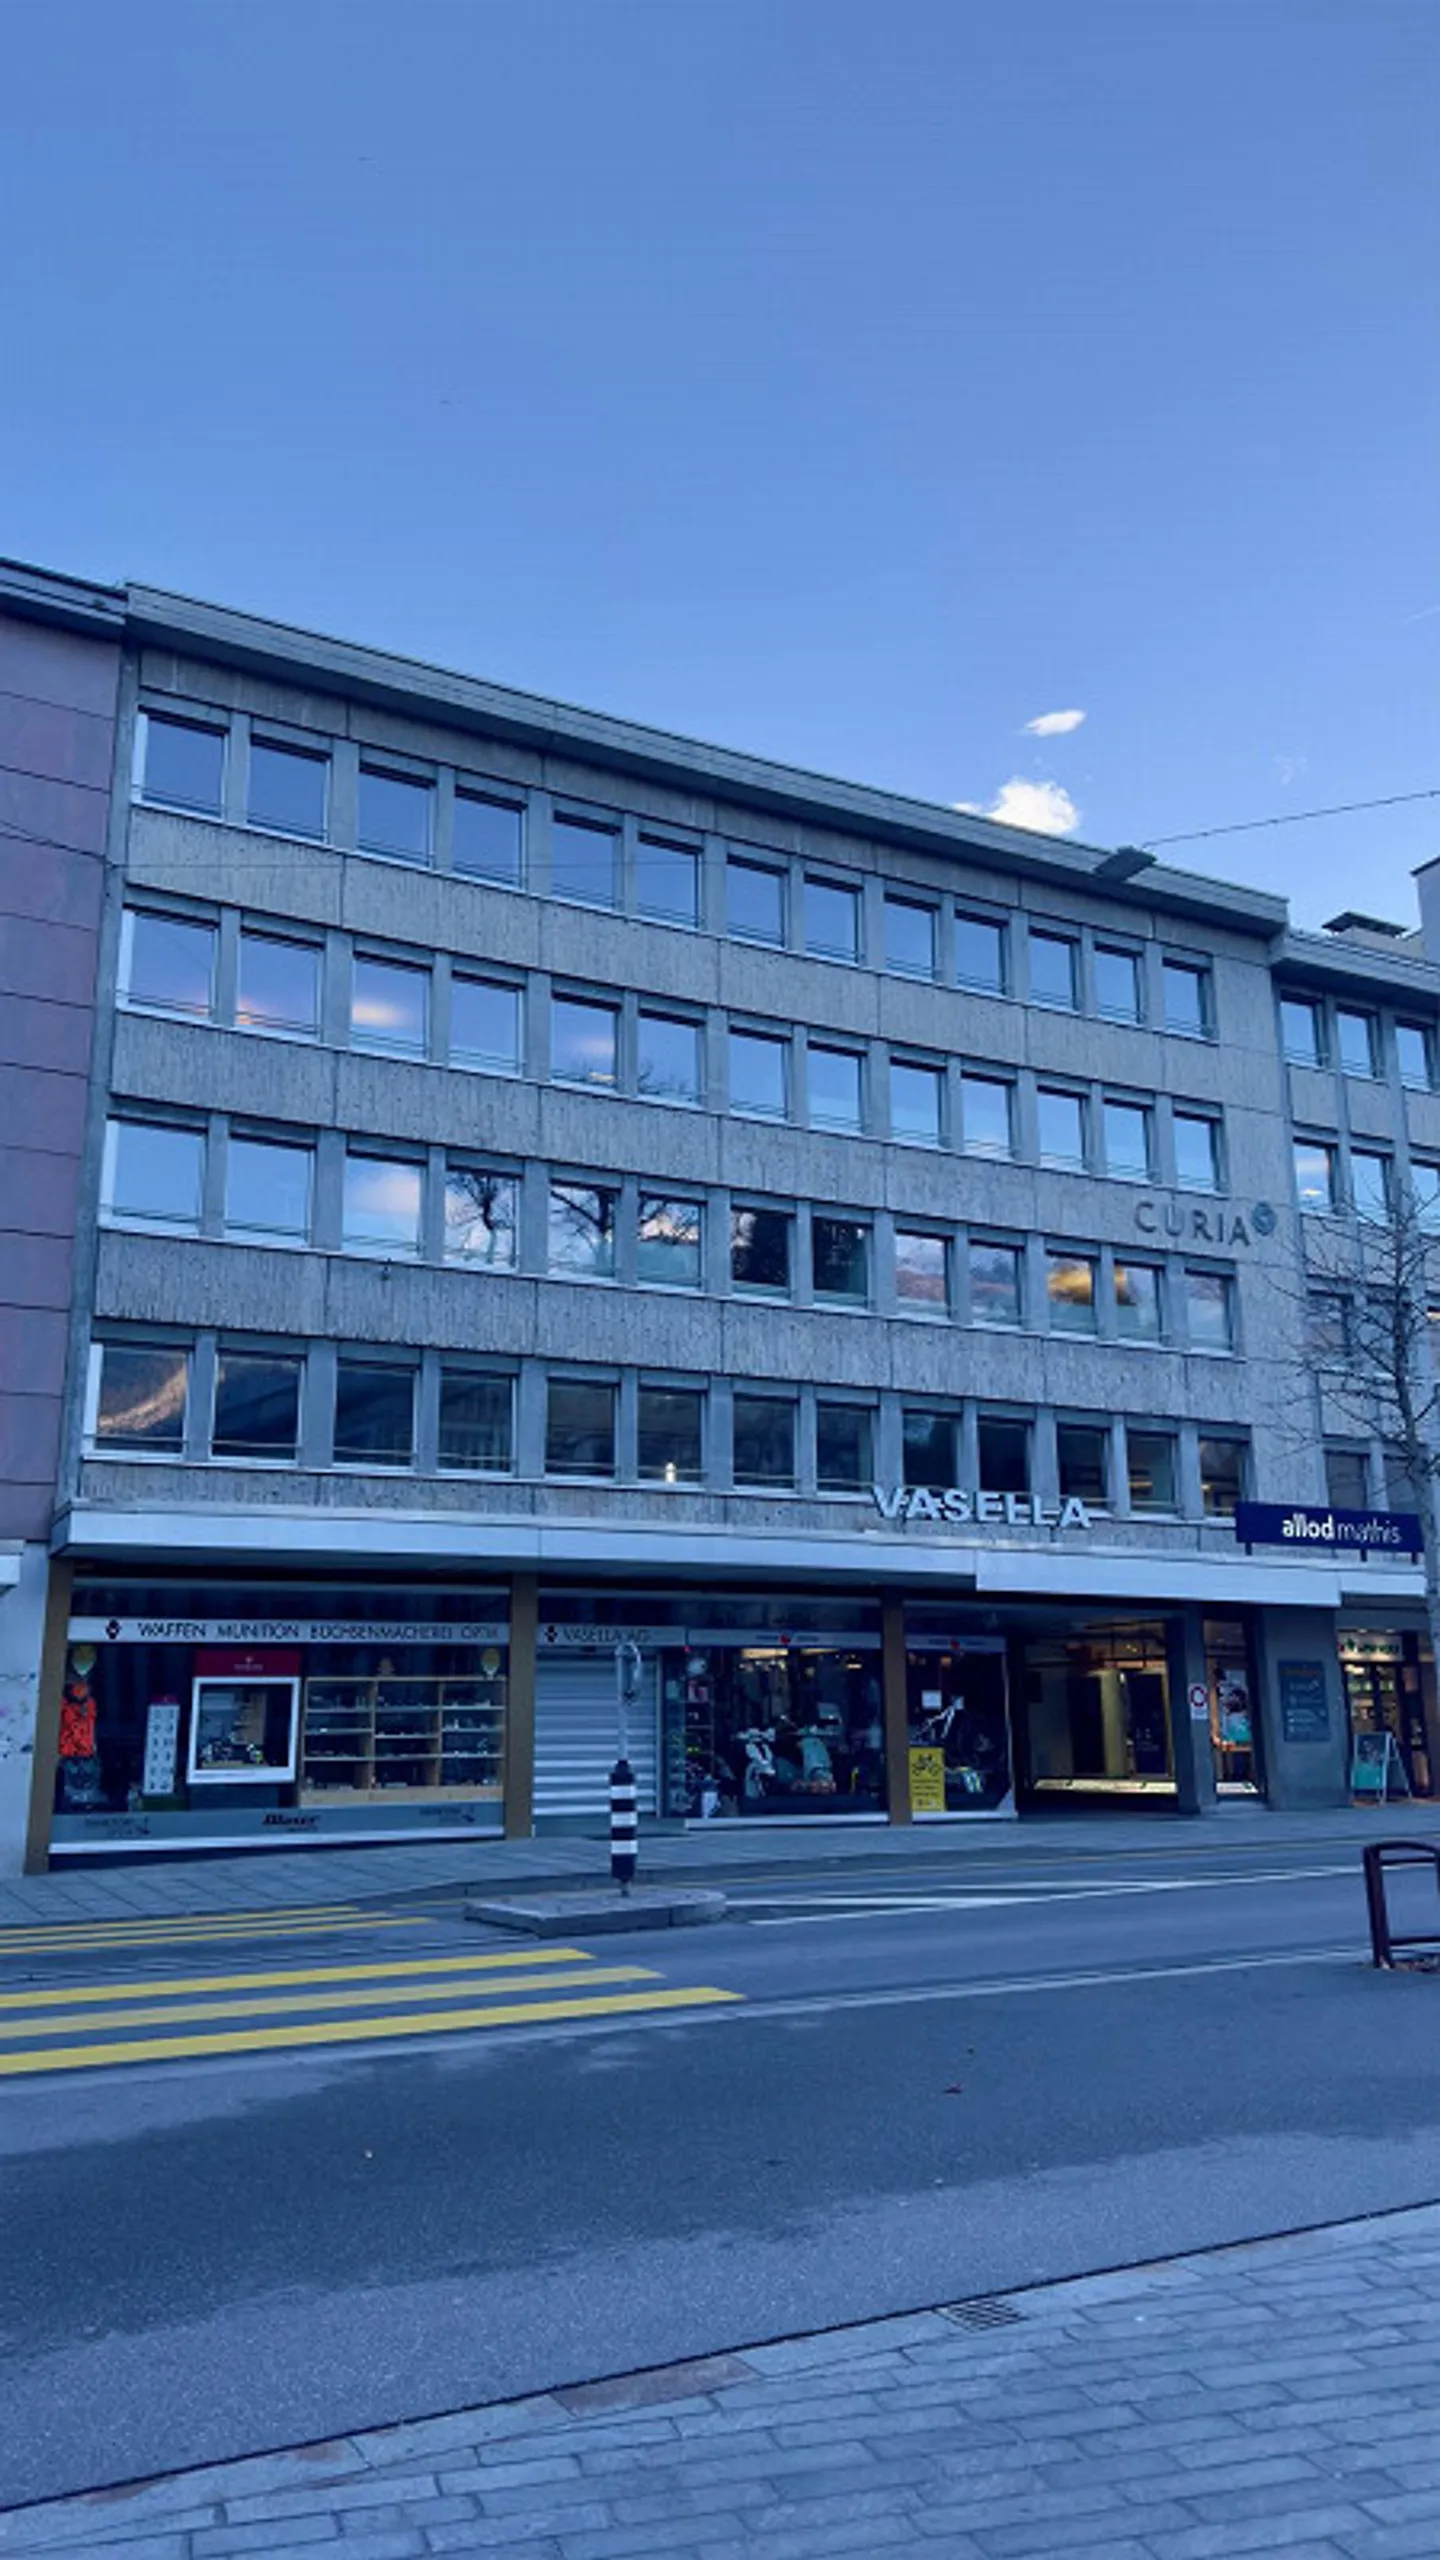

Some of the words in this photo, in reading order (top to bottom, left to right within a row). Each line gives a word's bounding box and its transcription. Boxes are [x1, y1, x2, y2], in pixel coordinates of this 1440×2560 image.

[1134, 1201, 1251, 1247] CURIA
[872, 1484, 1092, 1529] VASELLA
[137, 1621, 207, 1638] WAFFEN
[217, 1622, 299, 1640] MUNITION
